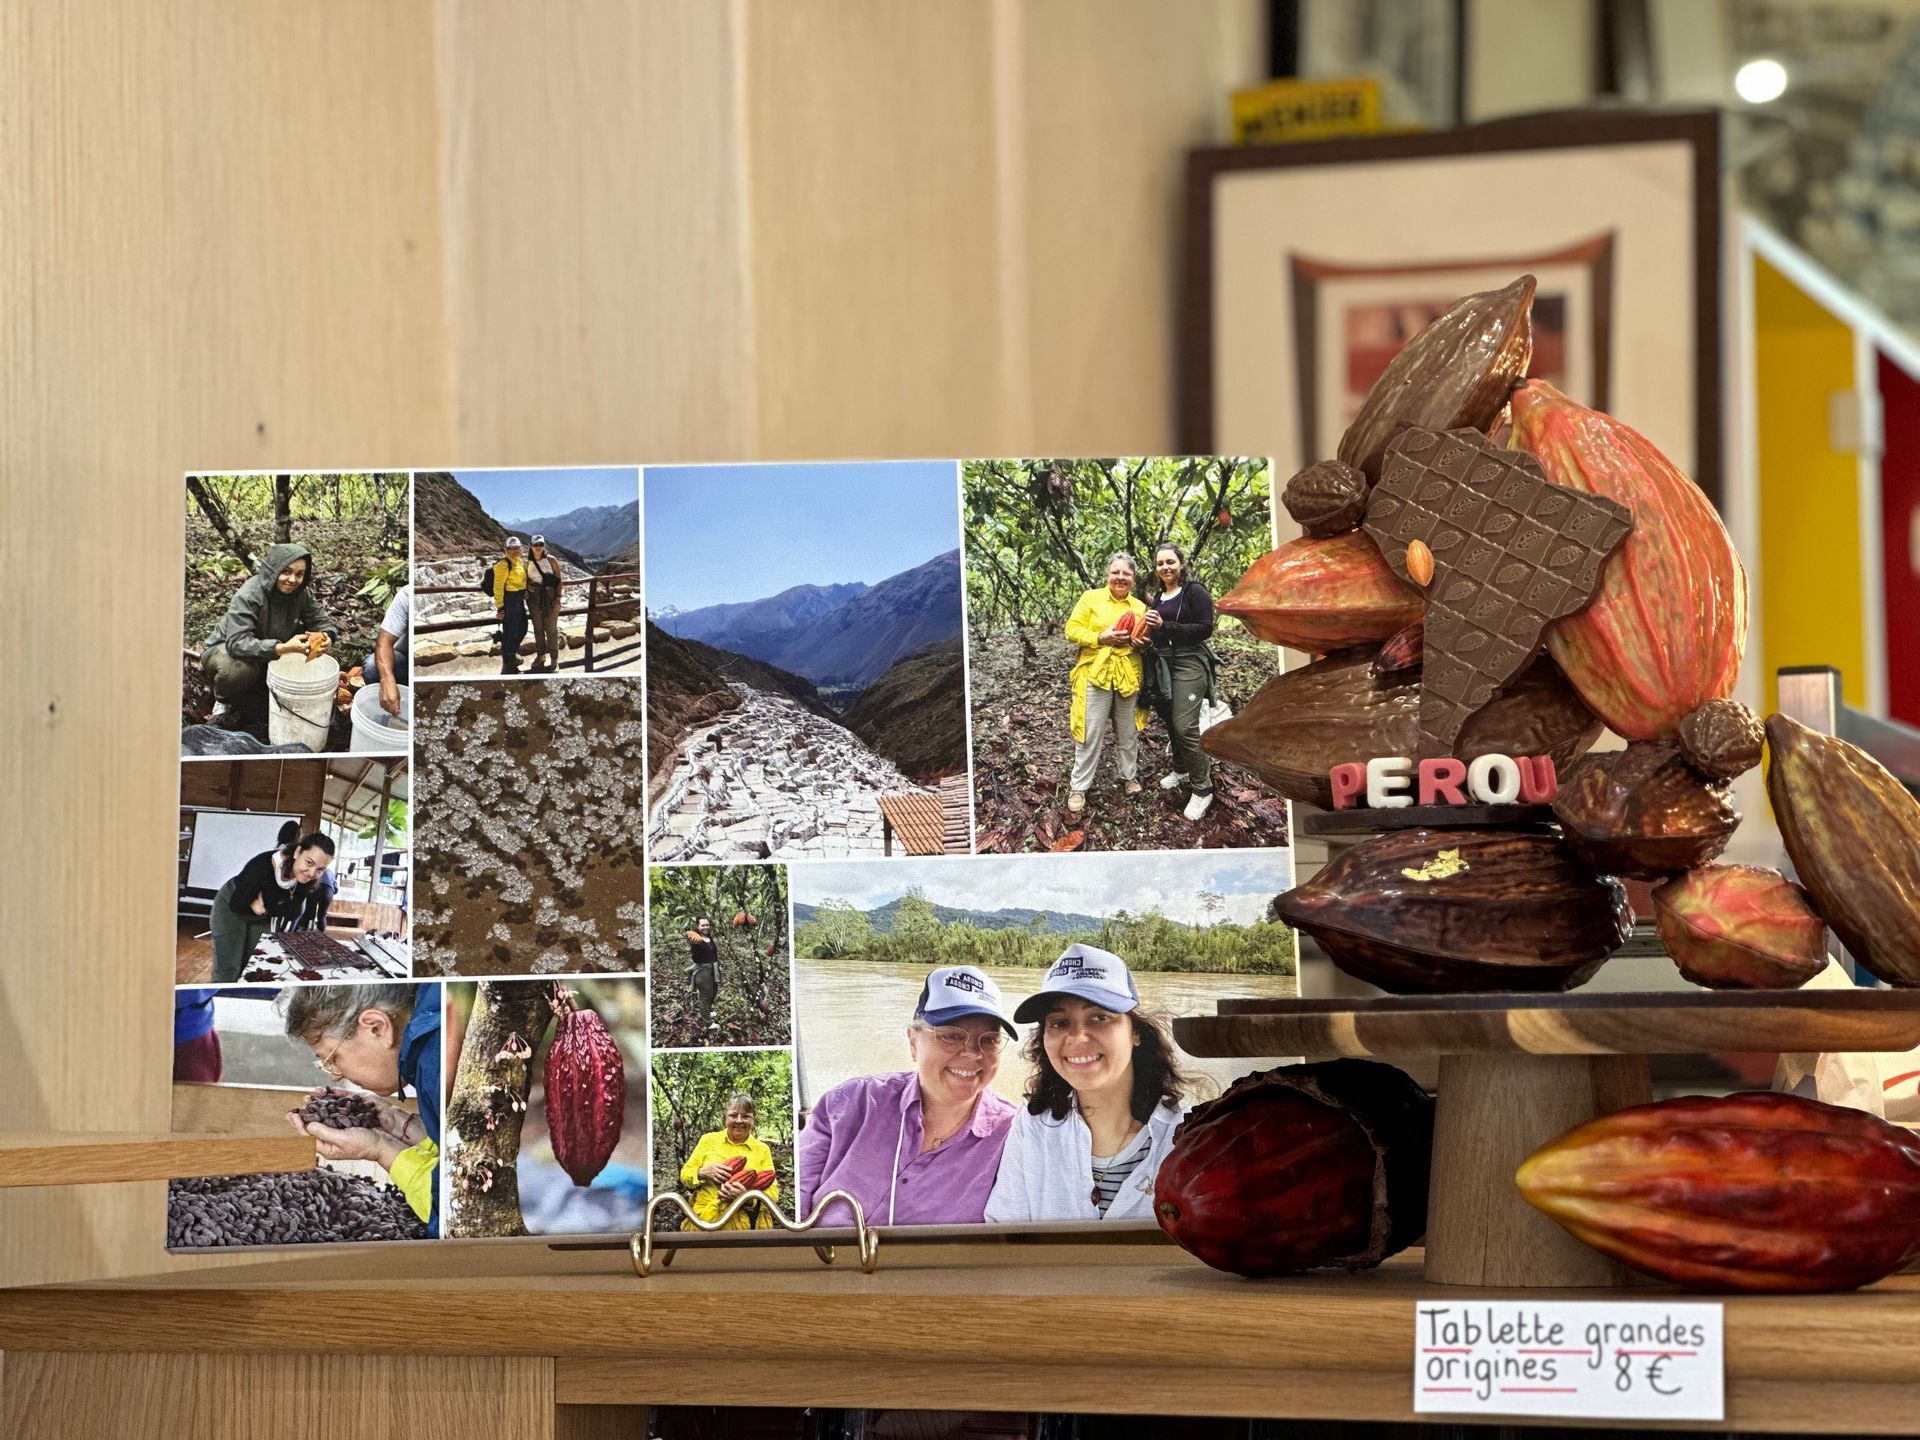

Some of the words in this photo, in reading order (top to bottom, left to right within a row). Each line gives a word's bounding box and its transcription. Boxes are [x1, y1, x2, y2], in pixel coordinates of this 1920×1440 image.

[1330, 753, 1558, 811] PEROU
[1420, 1308, 1564, 1346] Tablette
[1585, 1315, 1705, 1370] grandes
[1427, 1351, 1558, 1401] origines
[1614, 1353, 1632, 1392] 8
[1645, 1355, 1683, 1395] €
